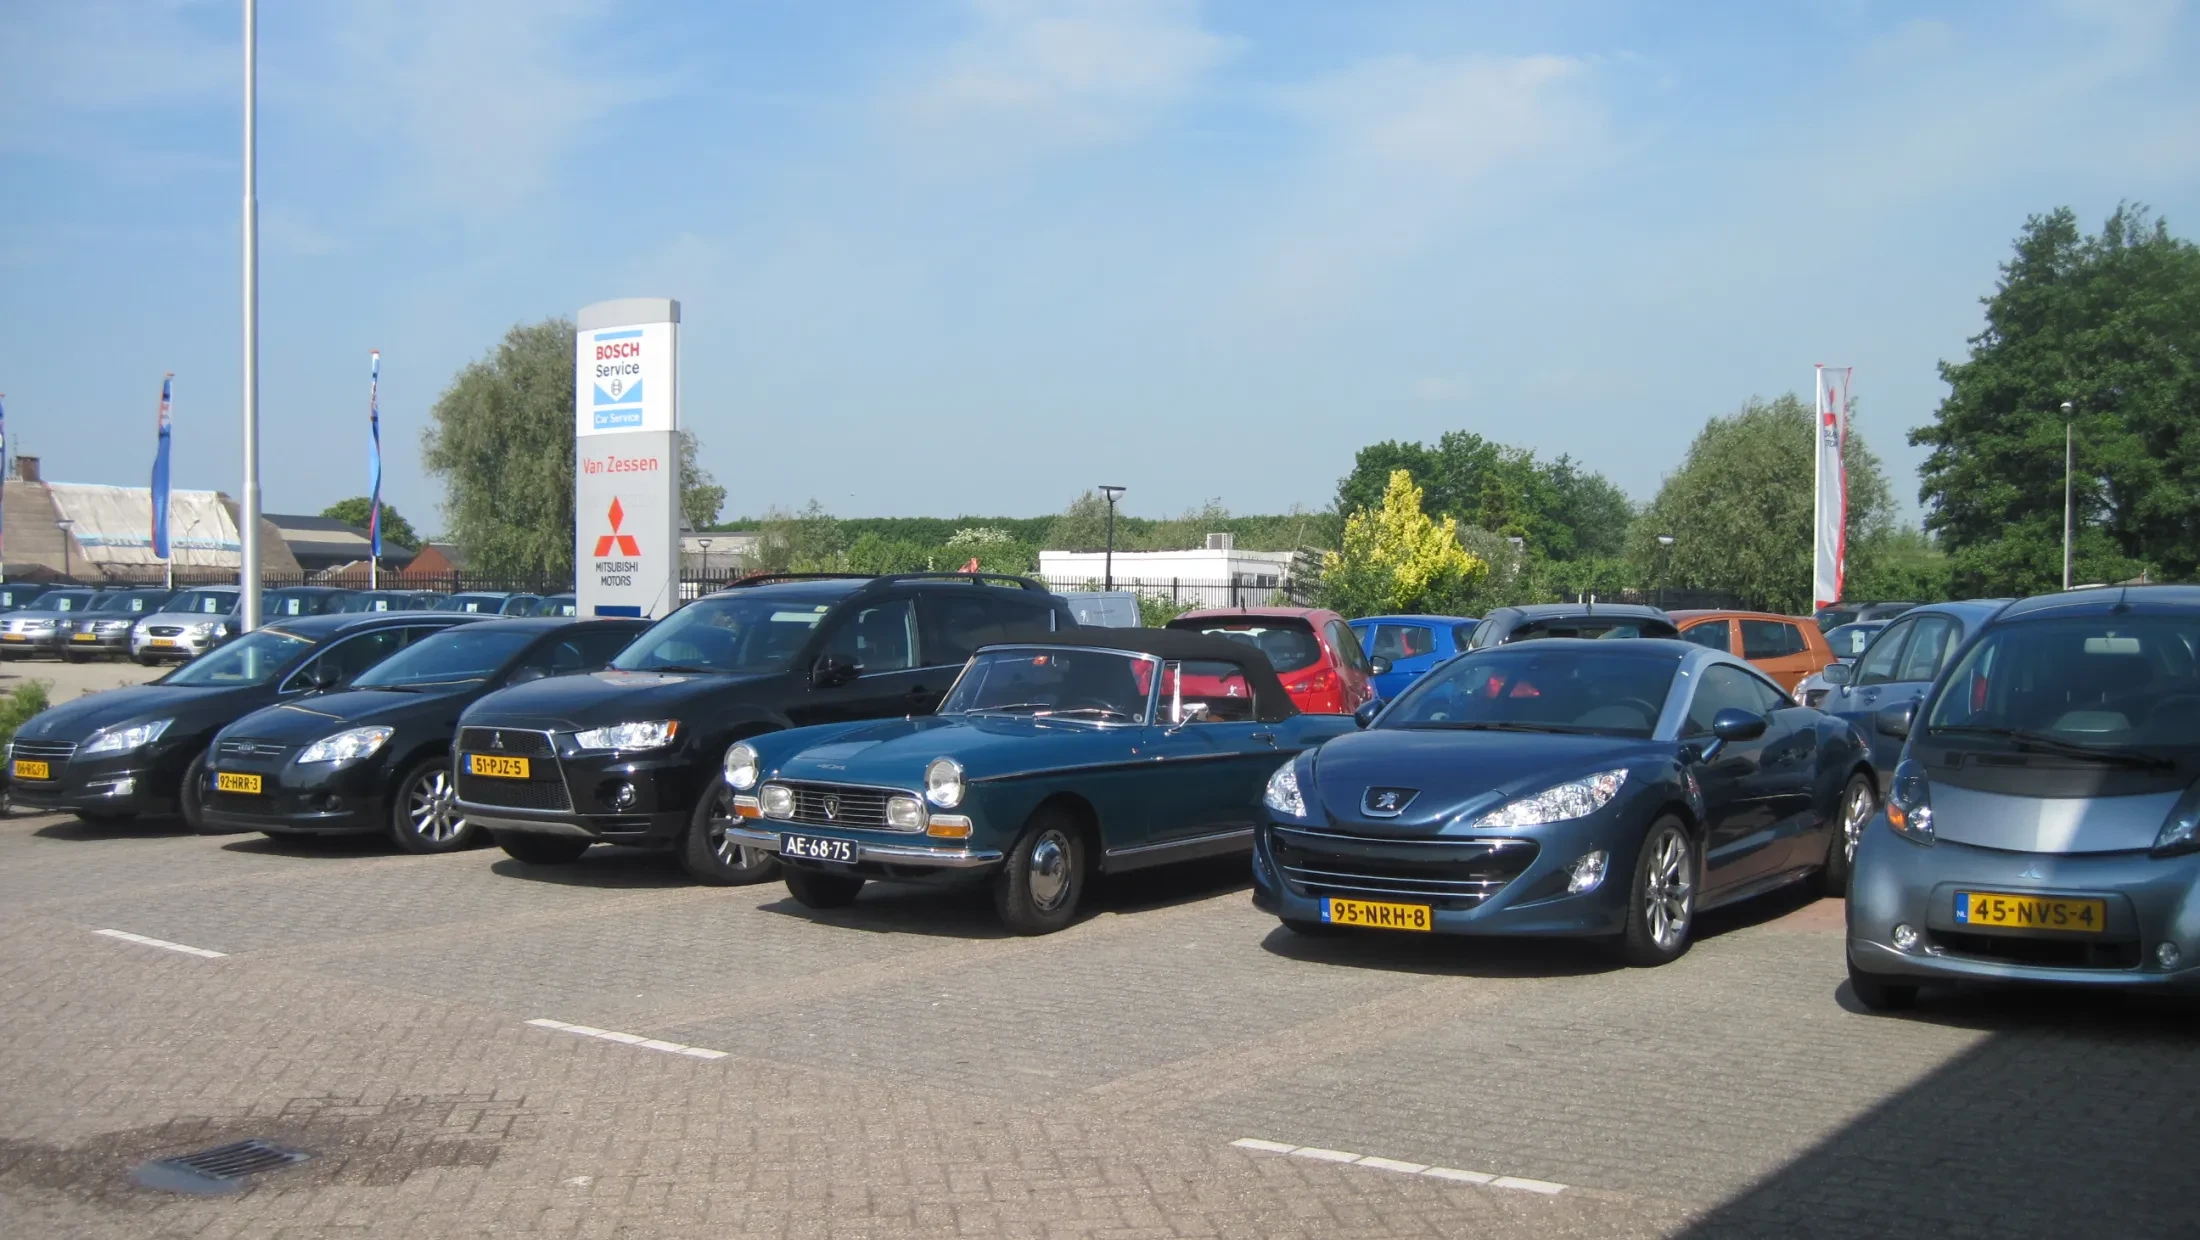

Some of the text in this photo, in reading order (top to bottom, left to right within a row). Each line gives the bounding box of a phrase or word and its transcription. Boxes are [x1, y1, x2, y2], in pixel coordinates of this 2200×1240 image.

[596, 341, 640, 360] BOSCH
[596, 361, 640, 378] Service
[595, 412, 641, 424] Car Service
[583, 455, 658, 474] Van Zessen
[595, 561, 639, 573] MITSUBISHI
[601, 575, 632, 587] MOTORS
[476, 757, 522, 775] 51-PJZ-5
[220, 775, 258, 791] 92-HRR-3
[786, 836, 850, 860] AE-68-75
[1334, 902, 1426, 928] 95-NRH-8
[1956, 898, 2094, 927] NL 45-NVS-4
